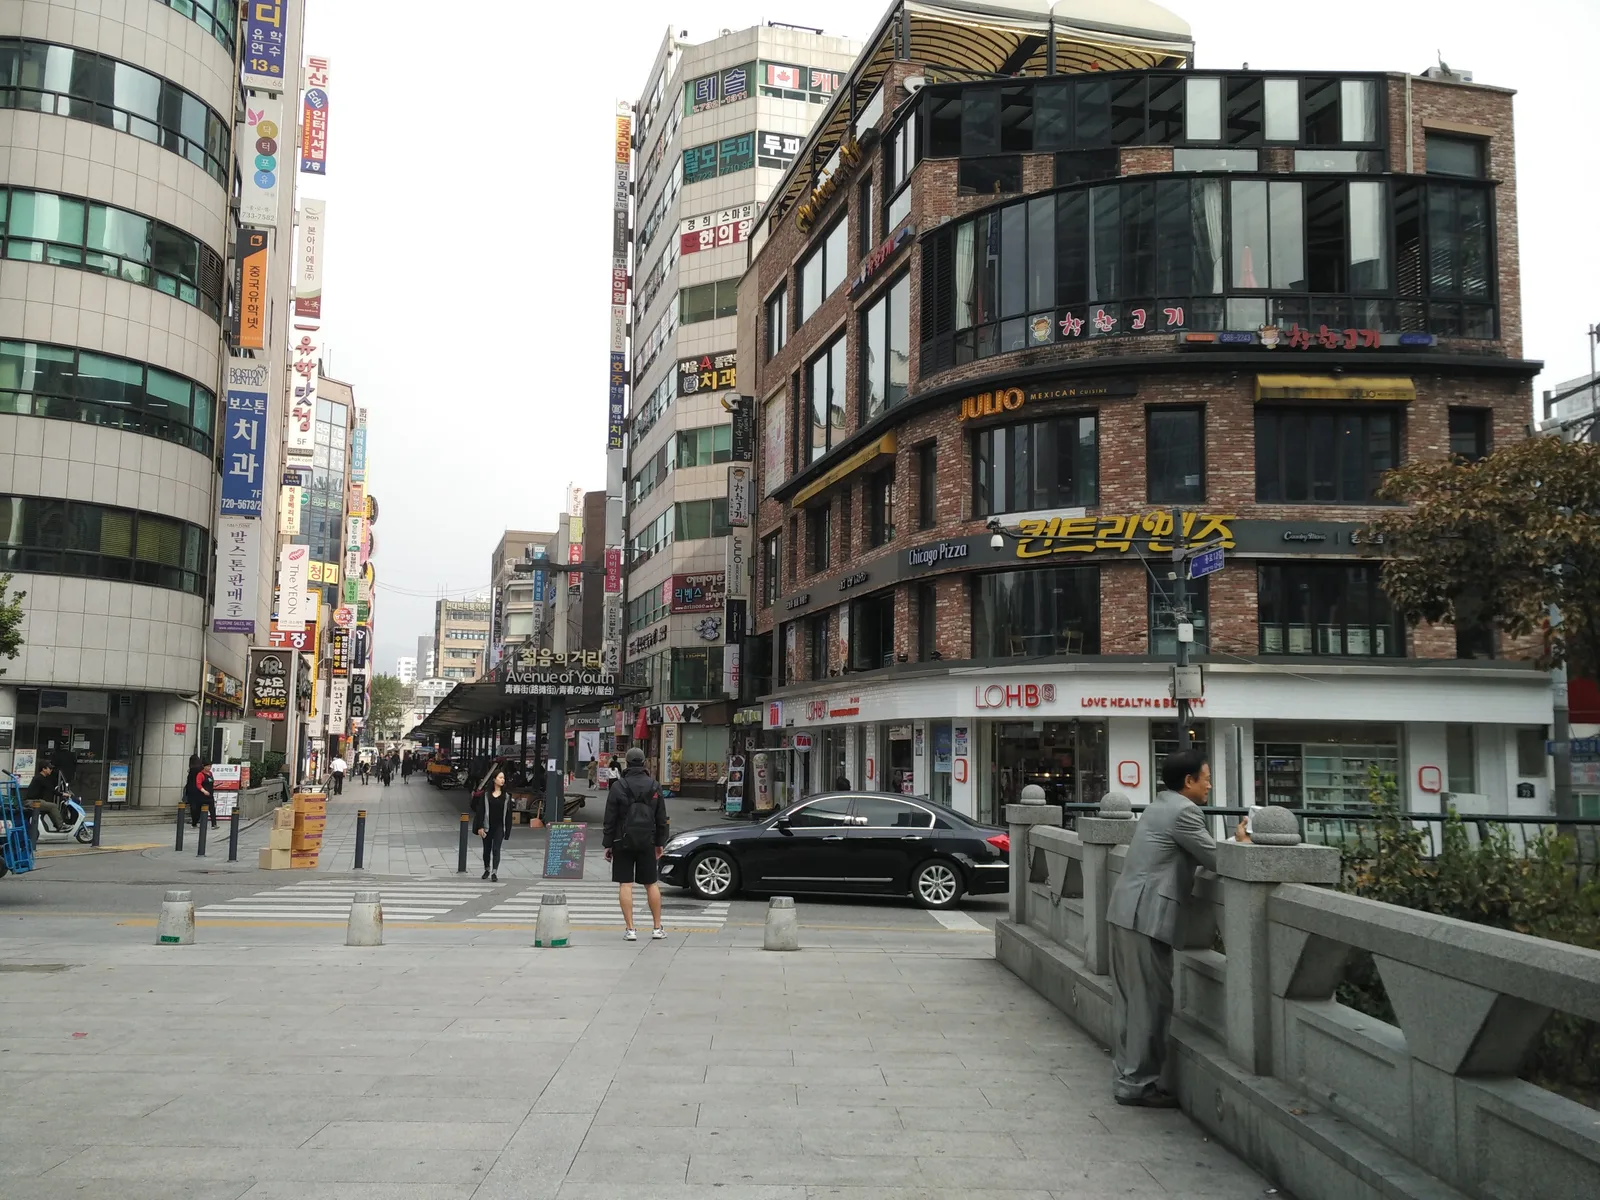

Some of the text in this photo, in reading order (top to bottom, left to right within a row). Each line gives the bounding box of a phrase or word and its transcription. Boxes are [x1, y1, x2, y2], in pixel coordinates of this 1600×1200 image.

[308, 57, 328, 88] 두산
[306, 90, 322, 109] Edu
[311, 109, 326, 160] 인터내셔널
[304, 161, 321, 171] 7층
[687, 206, 751, 230] 경희 스마일
[699, 220, 753, 249] 한의원
[1285, 323, 1380, 350] 착한고기
[229, 367, 265, 379] BOSTON
[611, 362, 623, 386] 호주
[679, 361, 699, 374] 서울
[700, 355, 713, 371] A
[229, 375, 263, 386] DENTAL
[700, 367, 737, 390] 치과
[228, 397, 266, 415] 보스톤
[957, 387, 1025, 421] JULIO
[1030, 389, 1077, 400] MEXICAN
[296, 437, 307, 445] 5F
[229, 418, 260, 484] 치과
[743, 451, 752, 460] 5F
[251, 490, 262, 498] 7F
[222, 498, 262, 511] 720-5673/2
[908, 543, 968, 566] Chicago Pizza
[288, 565, 299, 615] The YEON
[675, 587, 702, 603] 리벤스
[521, 648, 602, 667] 젊음의 거리
[506, 669, 615, 684] Avenue of Youth
[352, 684, 363, 715] BAR
[1081, 697, 1108, 708] LOVE
[1110, 697, 1151, 708] HEALTH
[1154, 698, 1160, 708] &
